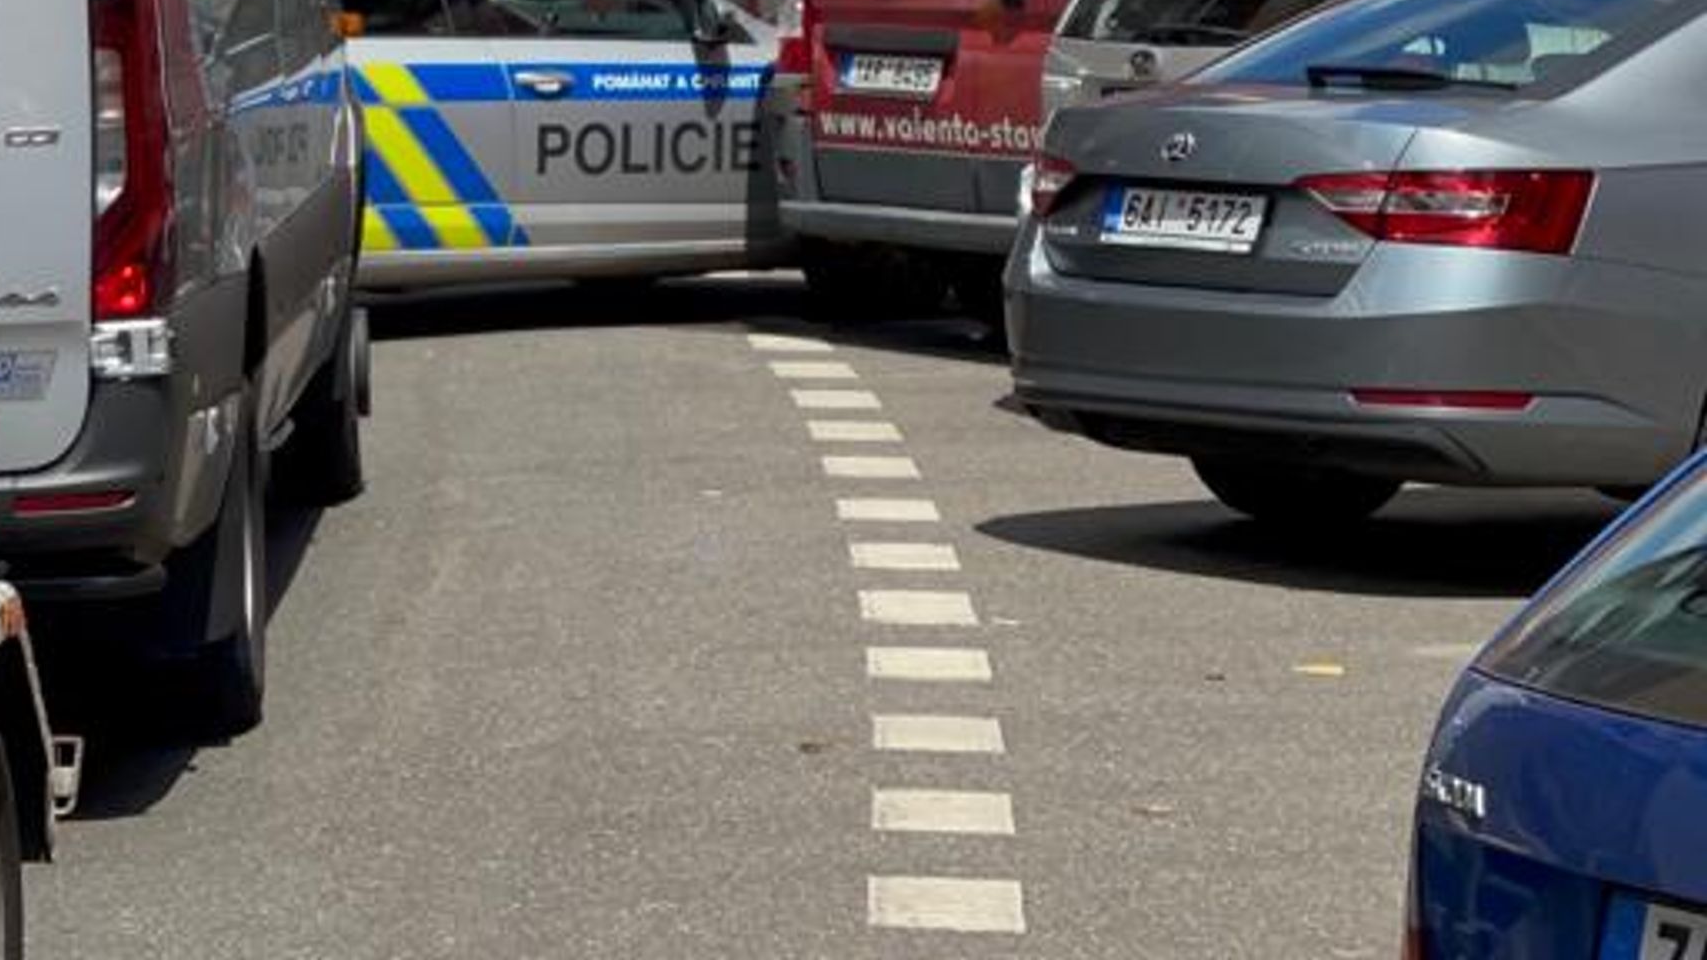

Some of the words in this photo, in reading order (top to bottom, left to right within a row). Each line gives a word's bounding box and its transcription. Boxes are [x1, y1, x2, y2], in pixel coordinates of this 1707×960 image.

[592, 71, 671, 90] POMÁHAT
[677, 74, 689, 89] A
[691, 72, 761, 91] CÁNIT
[537, 123, 762, 174] POLICIE
[1186, 198, 1254, 236] 5172
